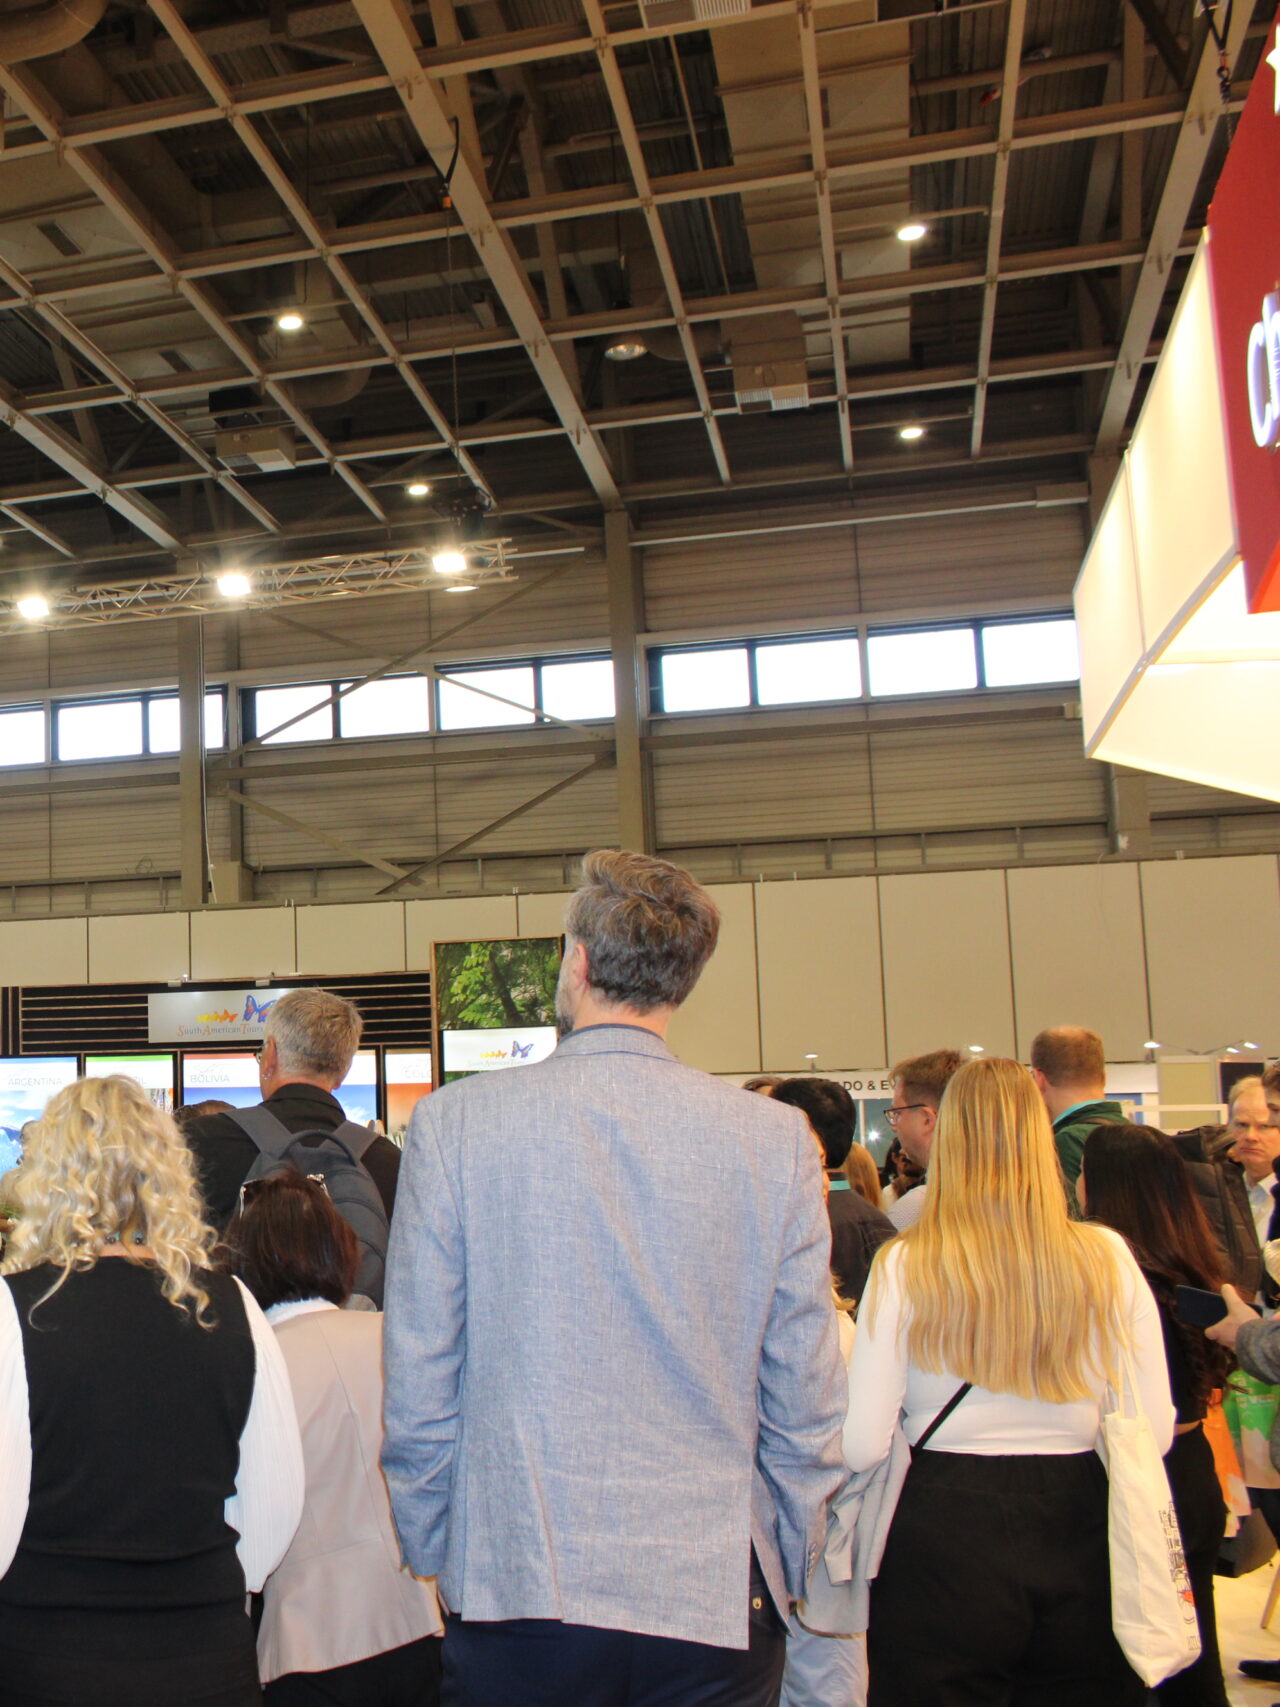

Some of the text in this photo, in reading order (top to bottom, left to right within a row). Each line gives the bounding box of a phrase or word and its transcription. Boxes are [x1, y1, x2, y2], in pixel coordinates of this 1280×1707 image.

[8, 1077, 63, 1087] ARGENTINA
[190, 1074, 231, 1084] BOLIVIA
[843, 1081, 863, 1091] DO
[867, 1081, 876, 1091] &
